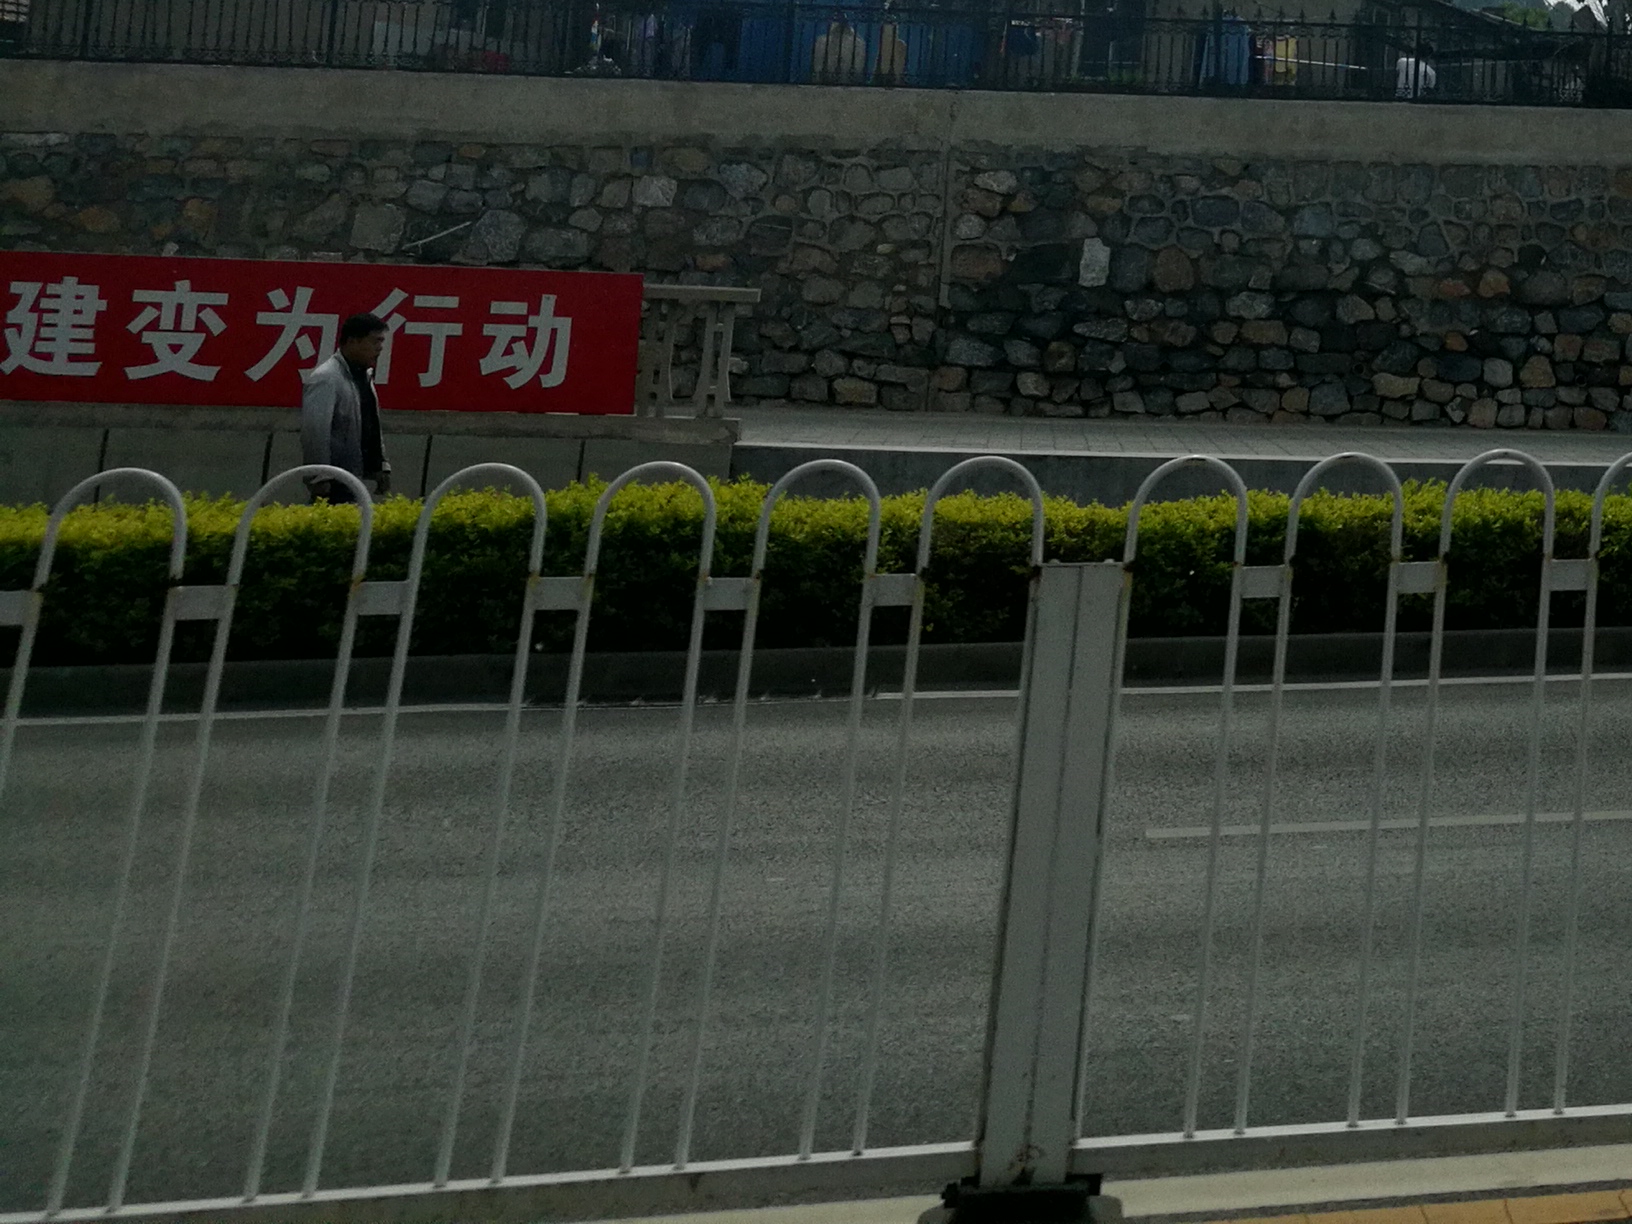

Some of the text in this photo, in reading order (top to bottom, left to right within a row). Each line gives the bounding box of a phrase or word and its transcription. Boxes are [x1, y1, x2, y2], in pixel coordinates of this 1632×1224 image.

[0, 276, 573, 390] 建变为行动
